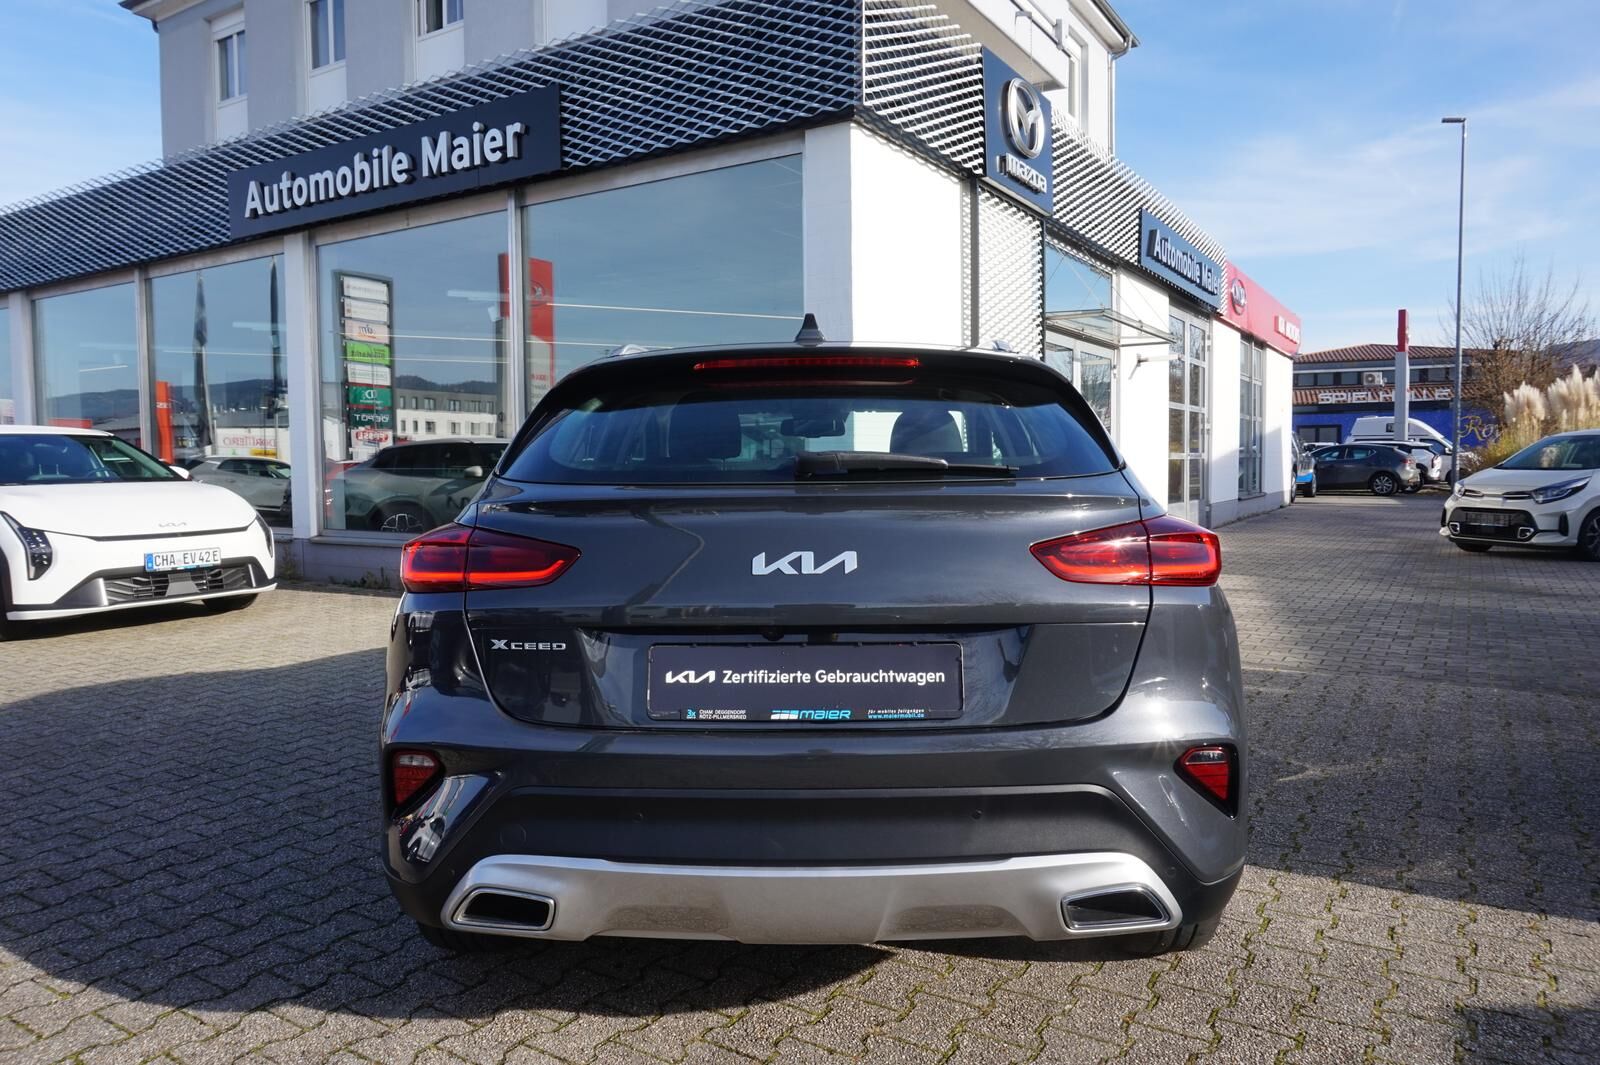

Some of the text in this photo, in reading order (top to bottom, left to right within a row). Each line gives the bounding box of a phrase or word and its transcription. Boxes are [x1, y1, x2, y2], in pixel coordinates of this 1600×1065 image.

[244, 122, 527, 218] Automobile Maier
[1154, 229, 1220, 294] Automobile Maier
[1318, 388, 1451, 404] SPIELHLLE
[154, 554, 176, 567] CHA
[752, 550, 858, 575] KIA
[665, 669, 946, 686] KIA Zertifizierte Gebrauchtwagen
